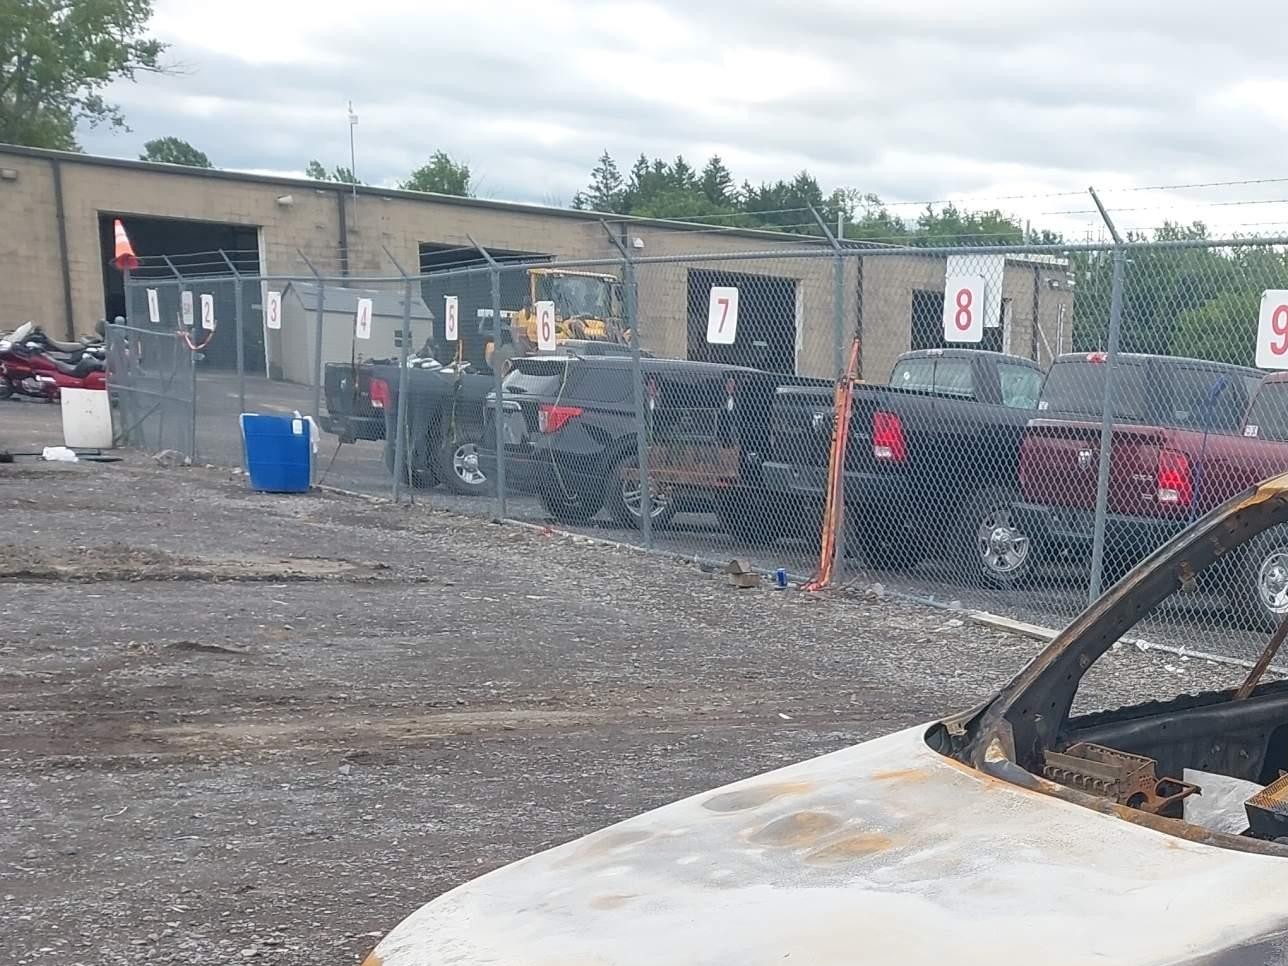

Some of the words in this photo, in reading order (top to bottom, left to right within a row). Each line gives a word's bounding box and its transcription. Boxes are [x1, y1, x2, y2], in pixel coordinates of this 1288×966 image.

[204, 301, 211, 323] 2
[271, 298, 278, 322] 3
[361, 306, 368, 331] 4
[448, 304, 455, 332] 5
[717, 298, 729, 334] 7
[955, 288, 973, 331] 8
[542, 310, 551, 342] 6
